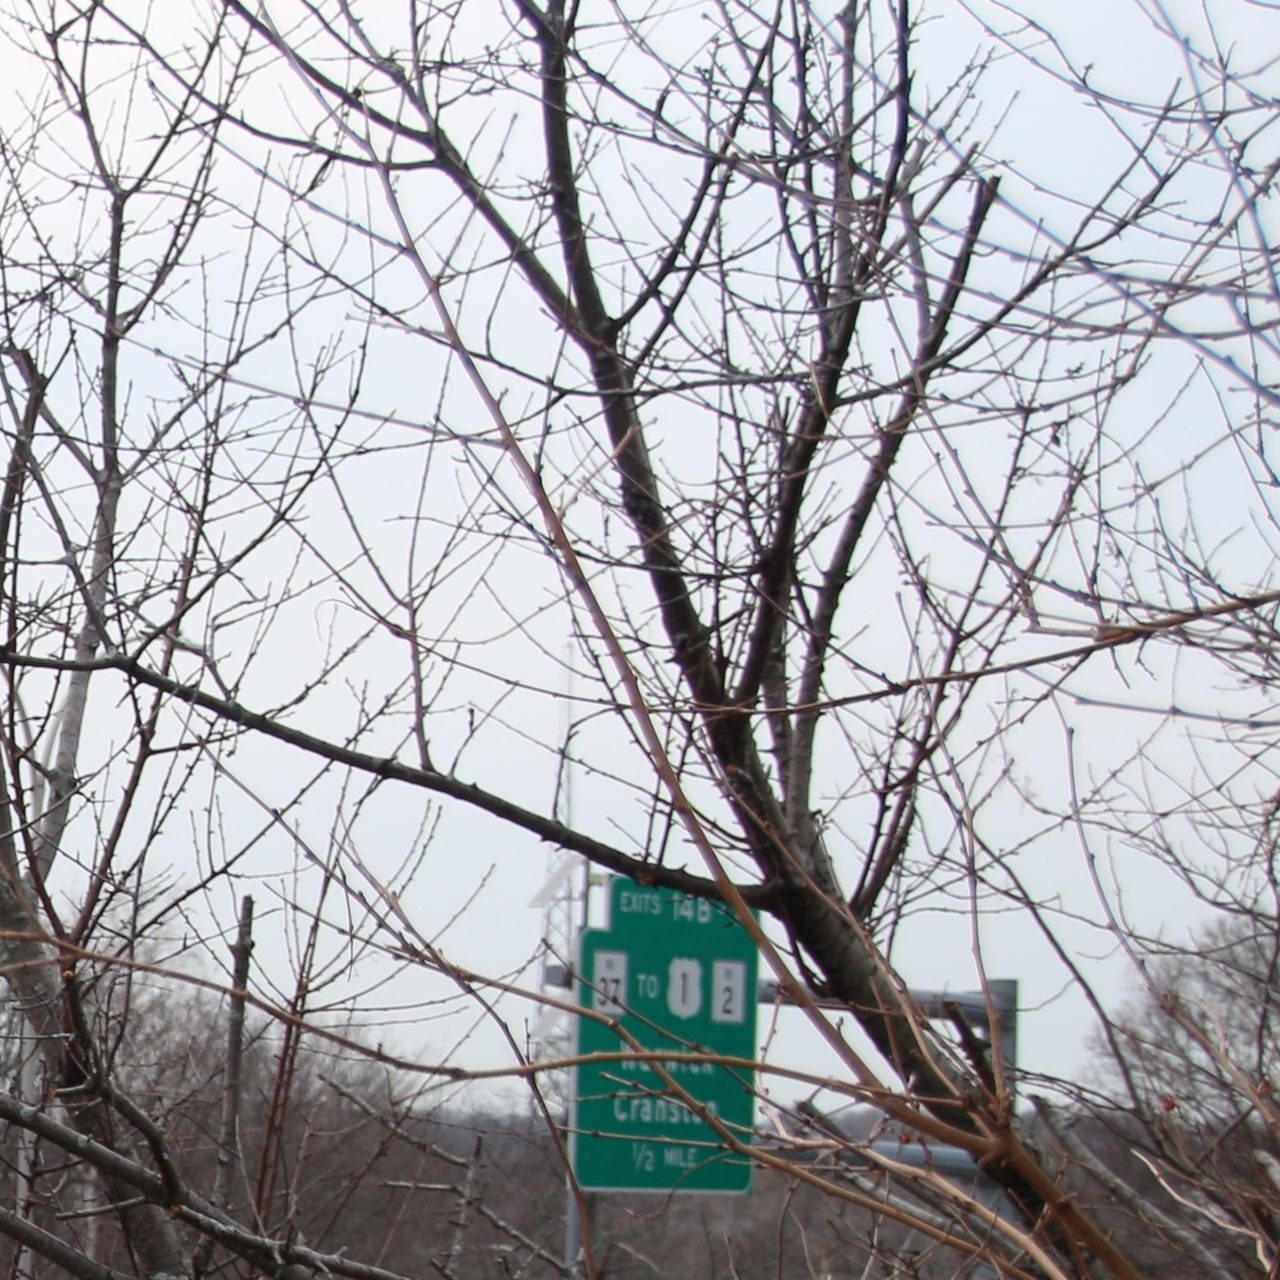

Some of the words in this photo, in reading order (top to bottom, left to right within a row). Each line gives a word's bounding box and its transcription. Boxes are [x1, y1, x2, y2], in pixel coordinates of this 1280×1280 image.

[620, 891, 661, 914] EXITS
[598, 977, 621, 1006] 37
[637, 974, 657, 998] TO
[681, 972, 687, 1005] 1
[721, 986, 734, 1014] 2
[664, 1147, 696, 1168] MILE
